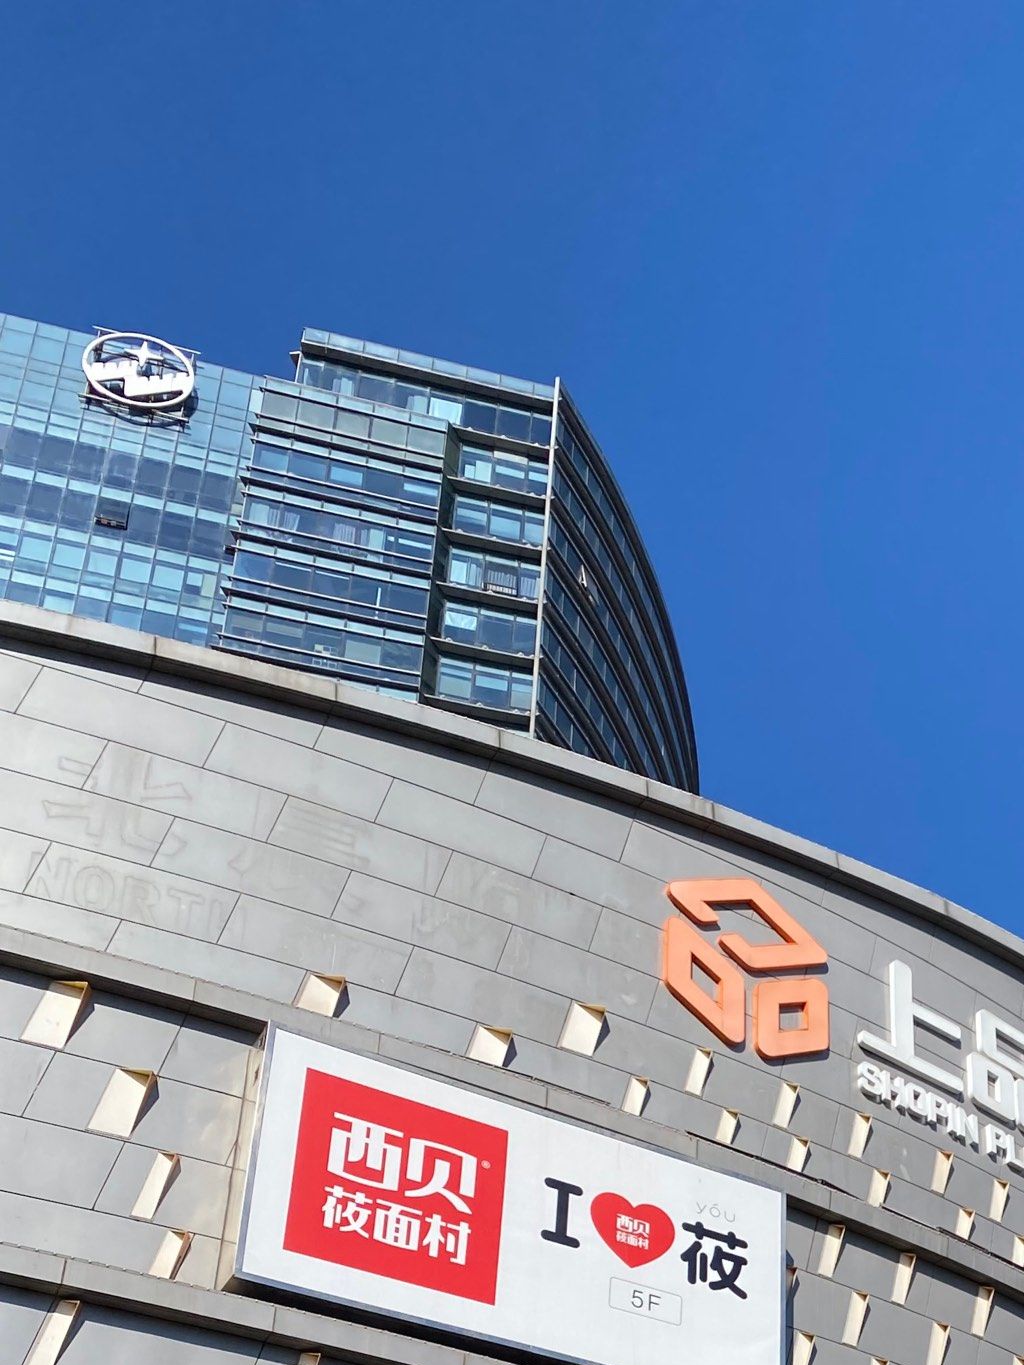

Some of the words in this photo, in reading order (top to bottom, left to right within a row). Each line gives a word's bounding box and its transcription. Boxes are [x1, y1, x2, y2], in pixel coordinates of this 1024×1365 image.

[857, 1061, 980, 1148] SHOPIN
[326, 1111, 478, 1215] 西贝
[321, 1184, 472, 1266] 莜面村
[540, 1176, 584, 1249] I
[680, 1220, 749, 1300] 莜
[615, 1212, 651, 1239] 西贝
[630, 1288, 662, 1312] 5F
